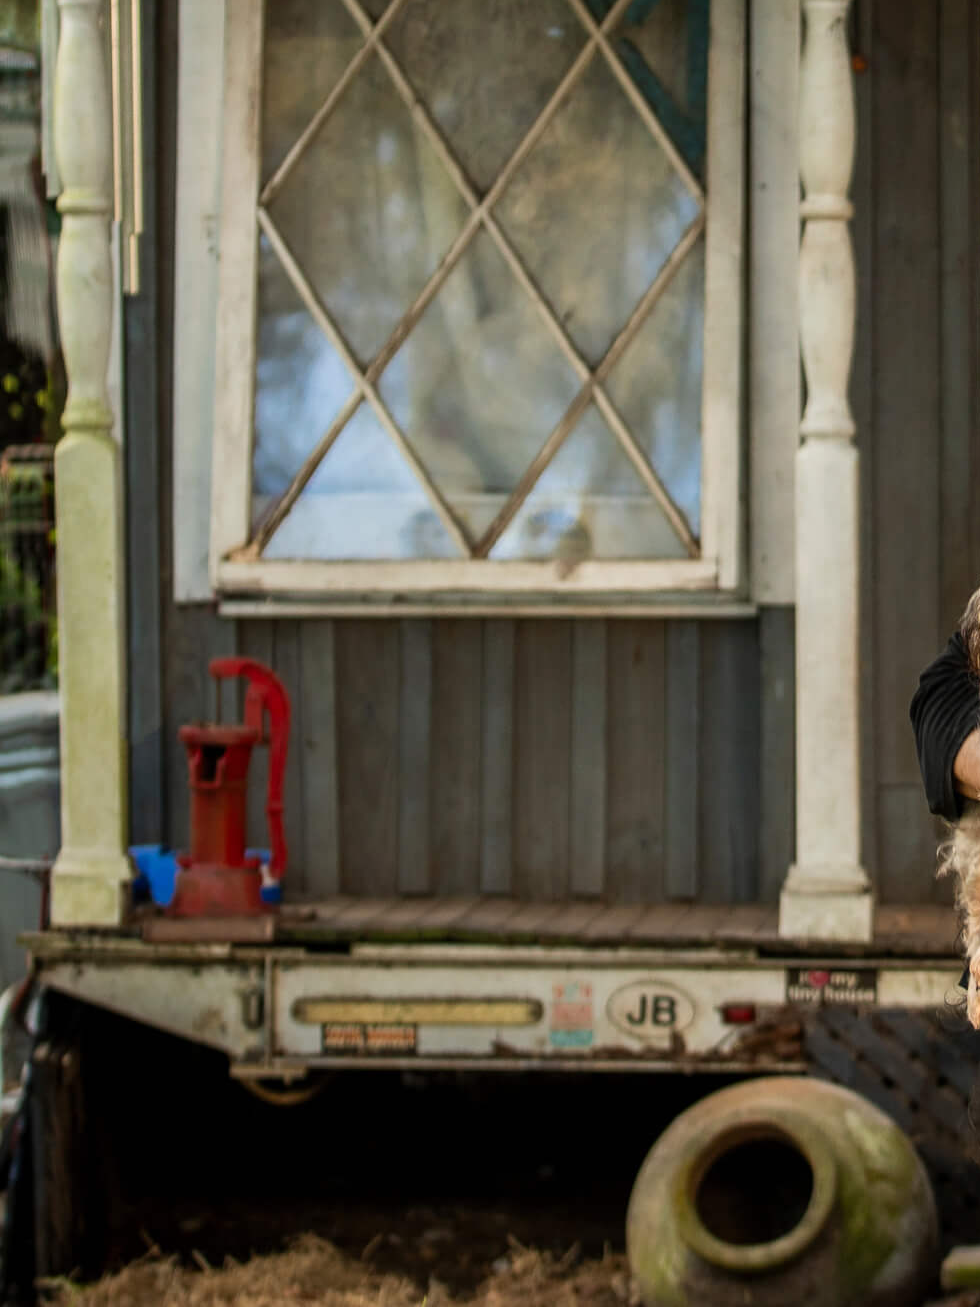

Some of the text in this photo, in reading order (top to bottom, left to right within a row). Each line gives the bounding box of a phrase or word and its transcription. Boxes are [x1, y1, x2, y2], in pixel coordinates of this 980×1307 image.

[831, 972, 857, 989] my
[789, 985, 874, 1003] tiny house
[625, 994, 677, 1026] JB
